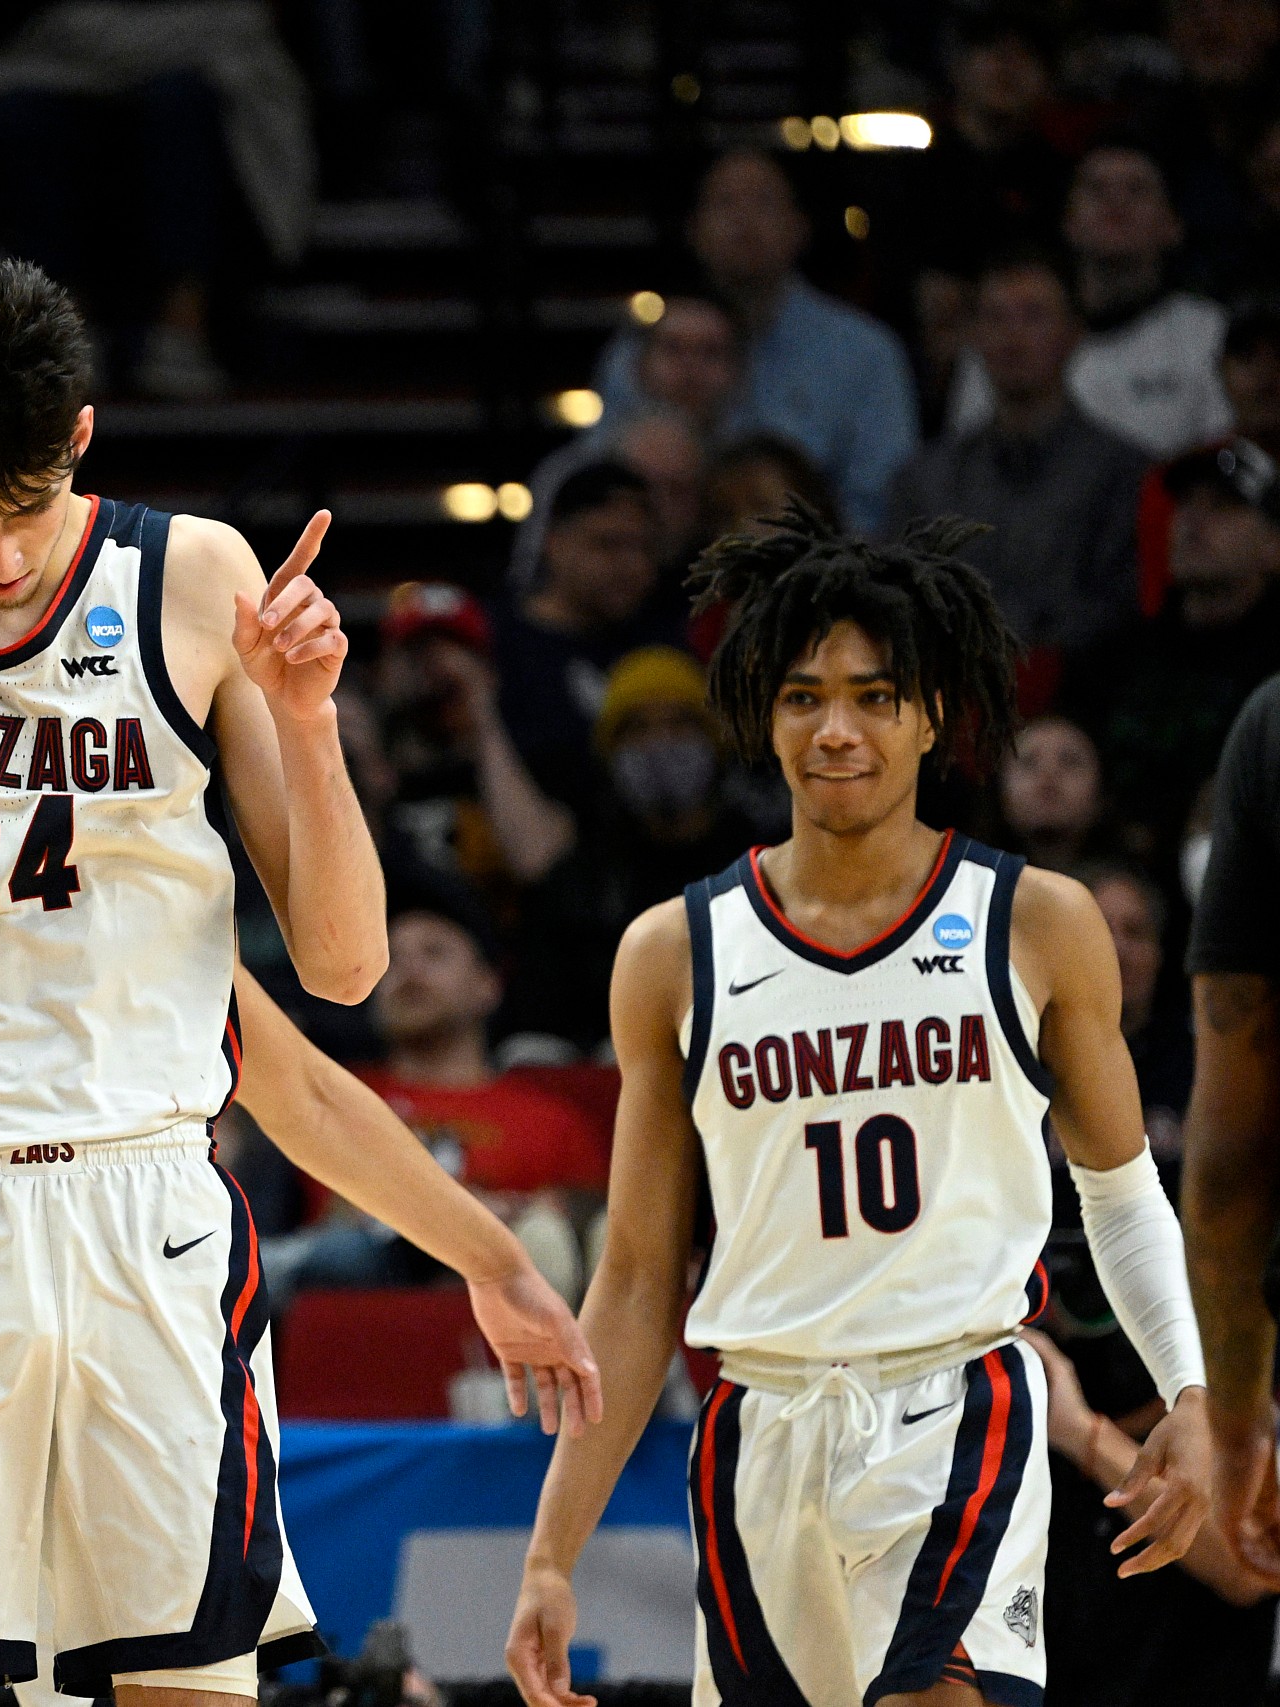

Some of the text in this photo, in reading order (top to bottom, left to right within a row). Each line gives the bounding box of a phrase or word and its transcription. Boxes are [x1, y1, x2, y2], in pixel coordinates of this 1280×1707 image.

[91, 625, 123, 637] NCAA
[60, 655, 119, 679] WCC
[911, 955, 965, 975] WCC
[719, 1014, 992, 1109] GONZAGA
[804, 1113, 921, 1239] 10
